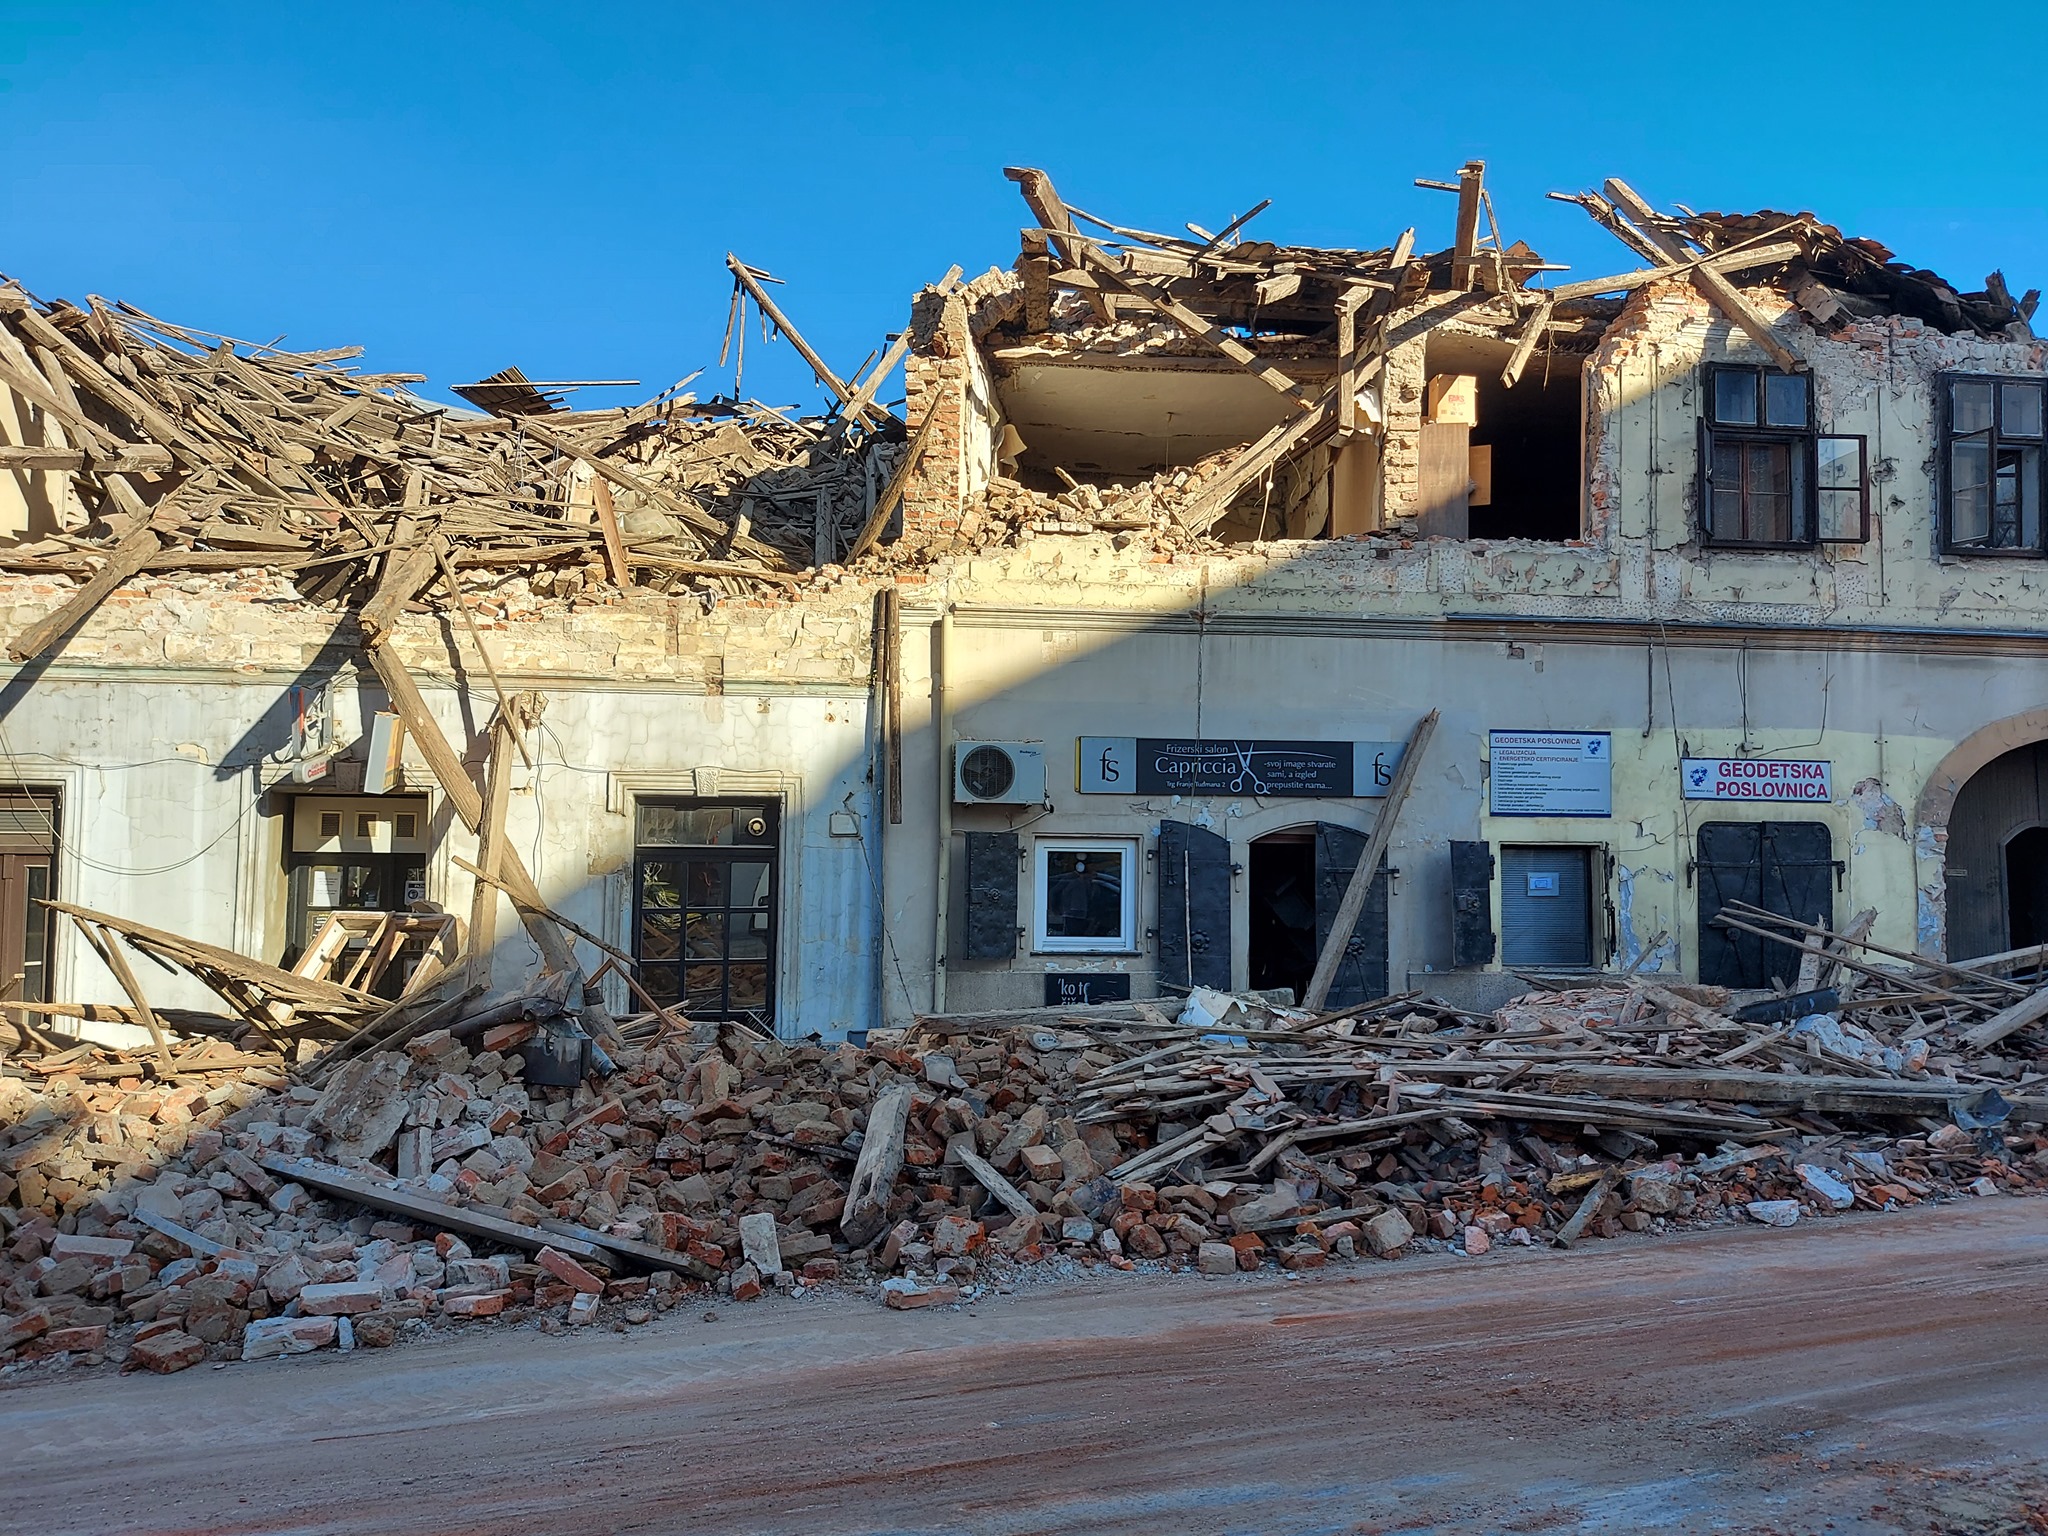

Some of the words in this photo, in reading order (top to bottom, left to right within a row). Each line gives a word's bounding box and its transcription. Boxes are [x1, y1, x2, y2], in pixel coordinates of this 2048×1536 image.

[1495, 736, 1536, 744] GEODETSKA
[1166, 743, 1203, 754] Frizerski
[1204, 744, 1229, 754] salon
[1099, 746, 1120, 783] fs
[1155, 756, 1237, 779] Capriccia
[1283, 760, 1306, 770] image
[1307, 761, 1337, 769] stvarate
[1371, 752, 1392, 787] fs
[1266, 770, 1287, 779] sami,
[1295, 770, 1317, 780] izgled
[1718, 762, 1825, 779] GEODETSKA
[1166, 780, 1176, 789] Trg
[1176, 780, 1194, 789] Franje
[1266, 780, 1304, 791] prepustite
[1716, 781, 1828, 798] POSLOVNICA
